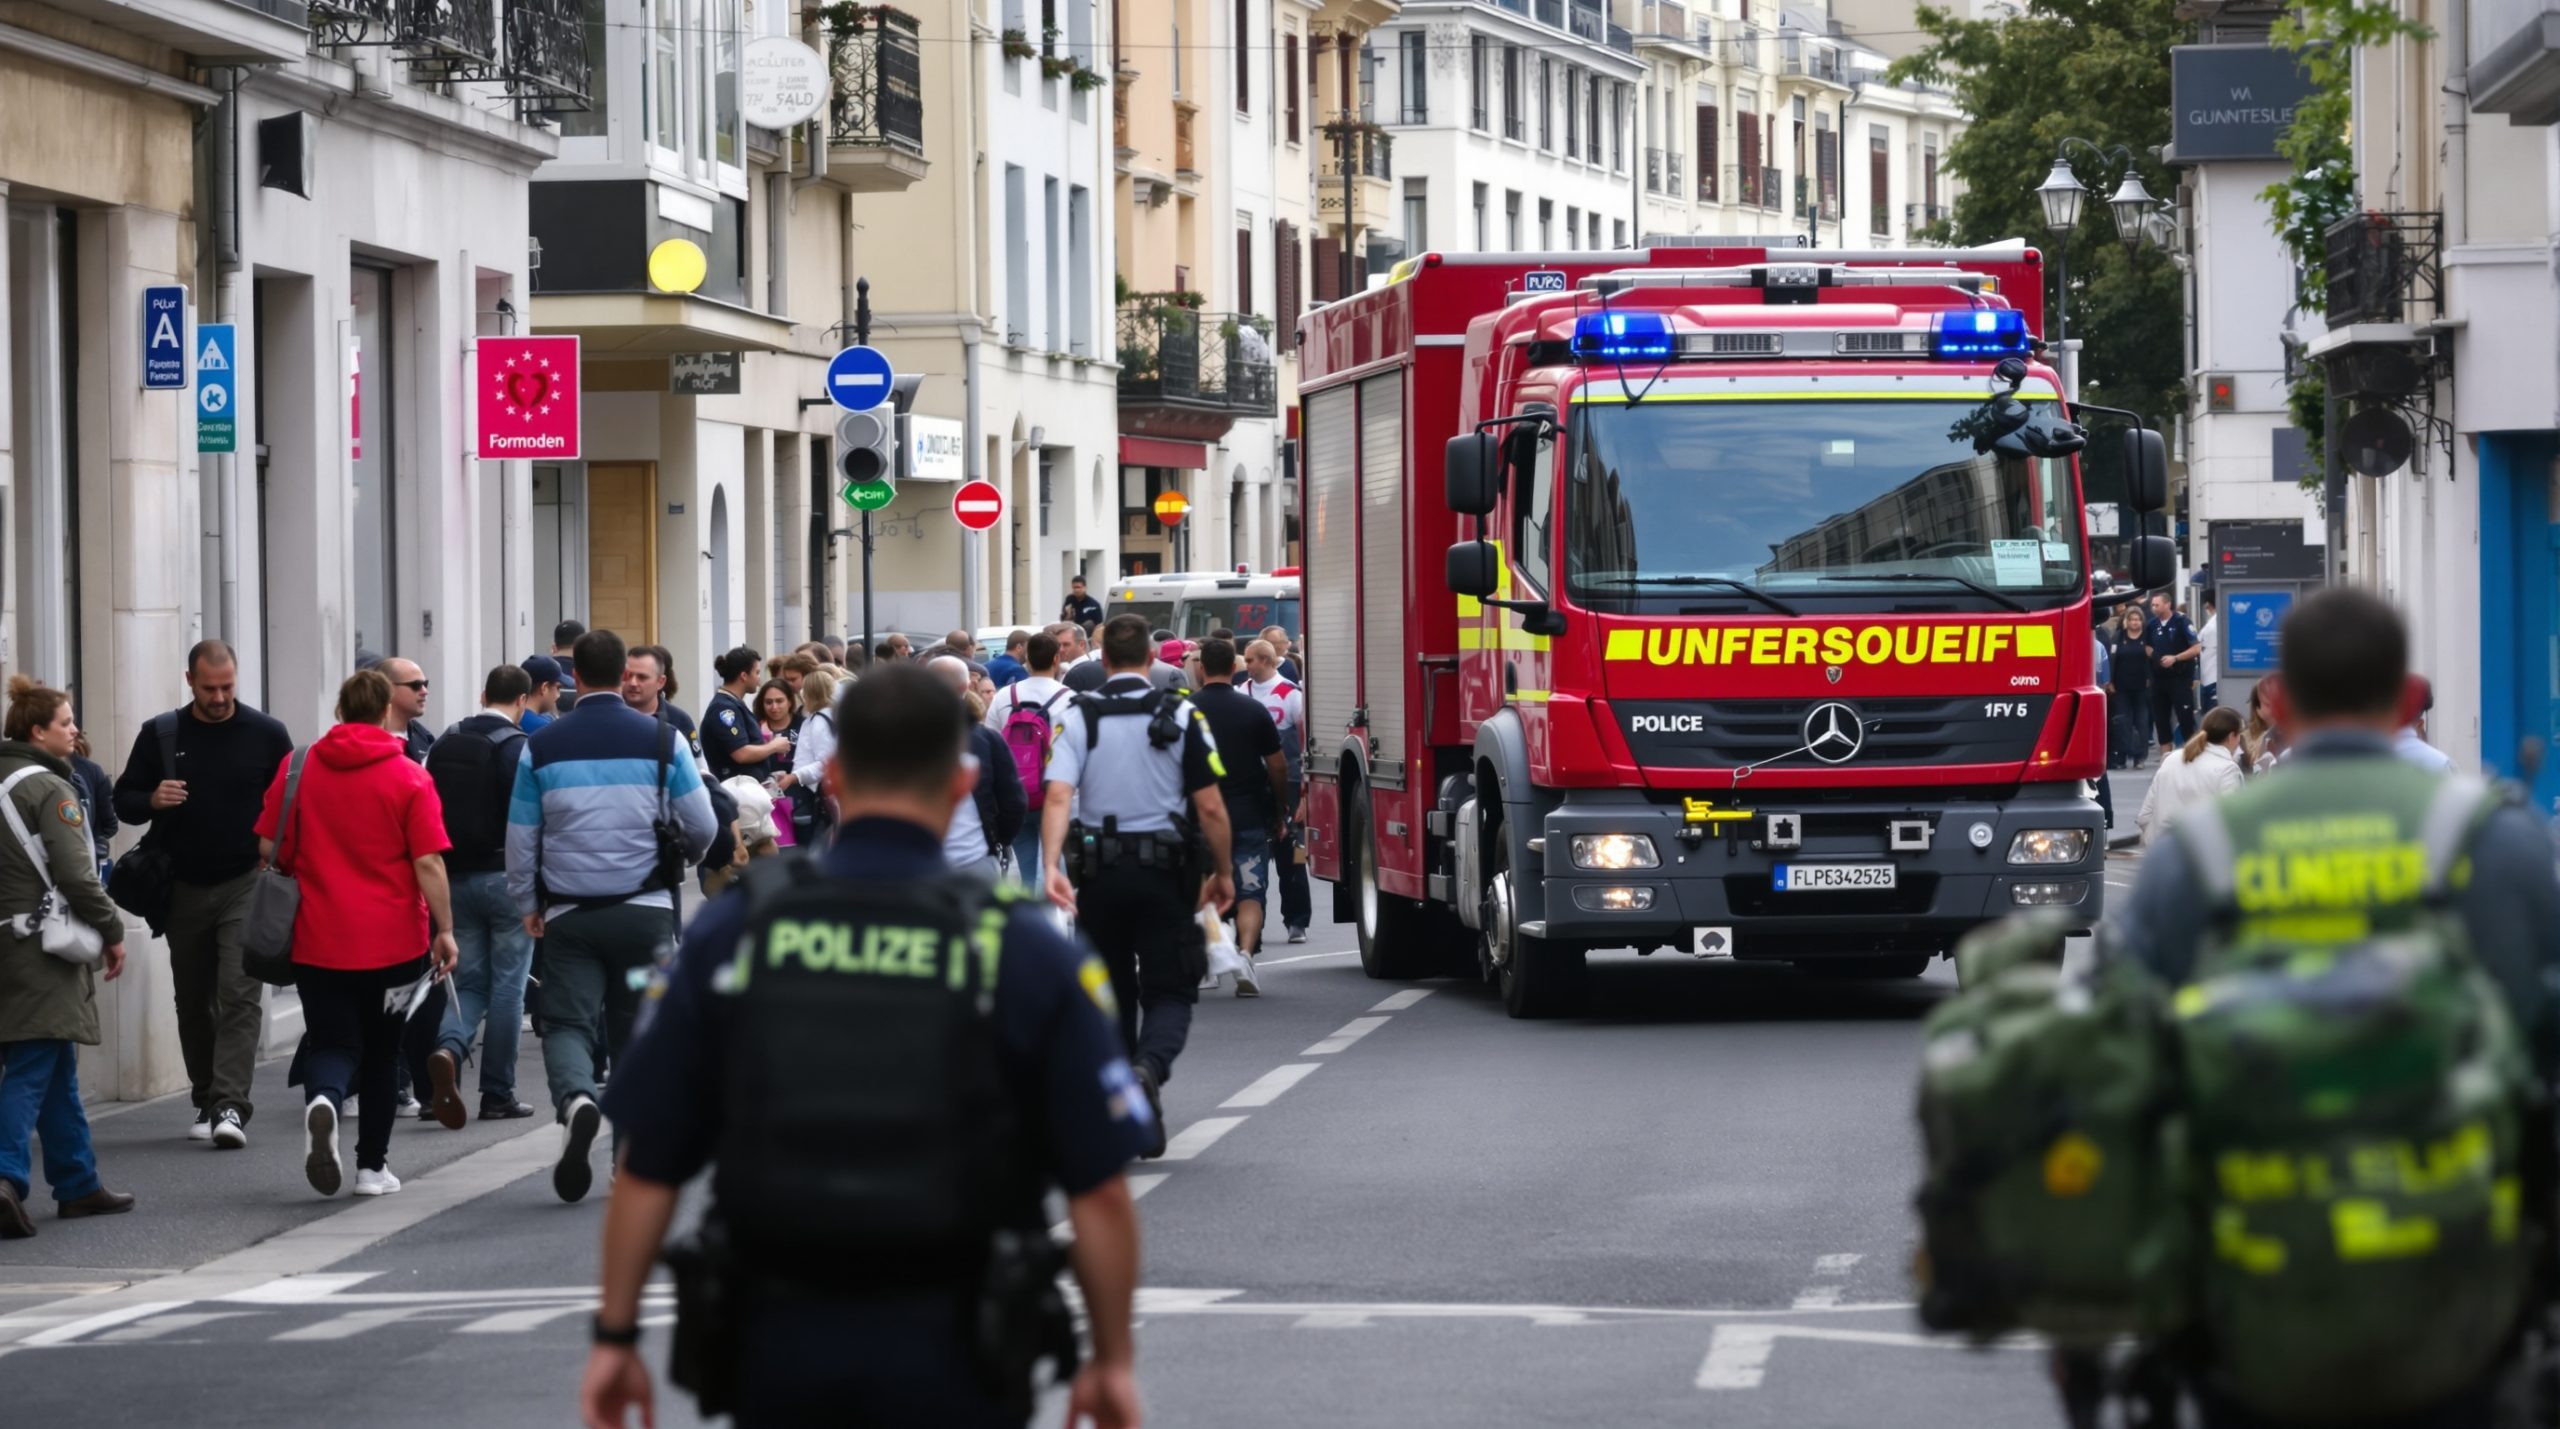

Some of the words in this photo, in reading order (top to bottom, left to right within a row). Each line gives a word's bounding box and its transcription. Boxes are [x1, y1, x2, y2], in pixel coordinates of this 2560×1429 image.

[151, 312, 180, 349] A
[489, 433, 565, 449] Formoden
[1646, 625, 2014, 667] UNFERSOUEIF
[1631, 714, 1703, 732] POLICE
[767, 920, 940, 978] POLIZE
